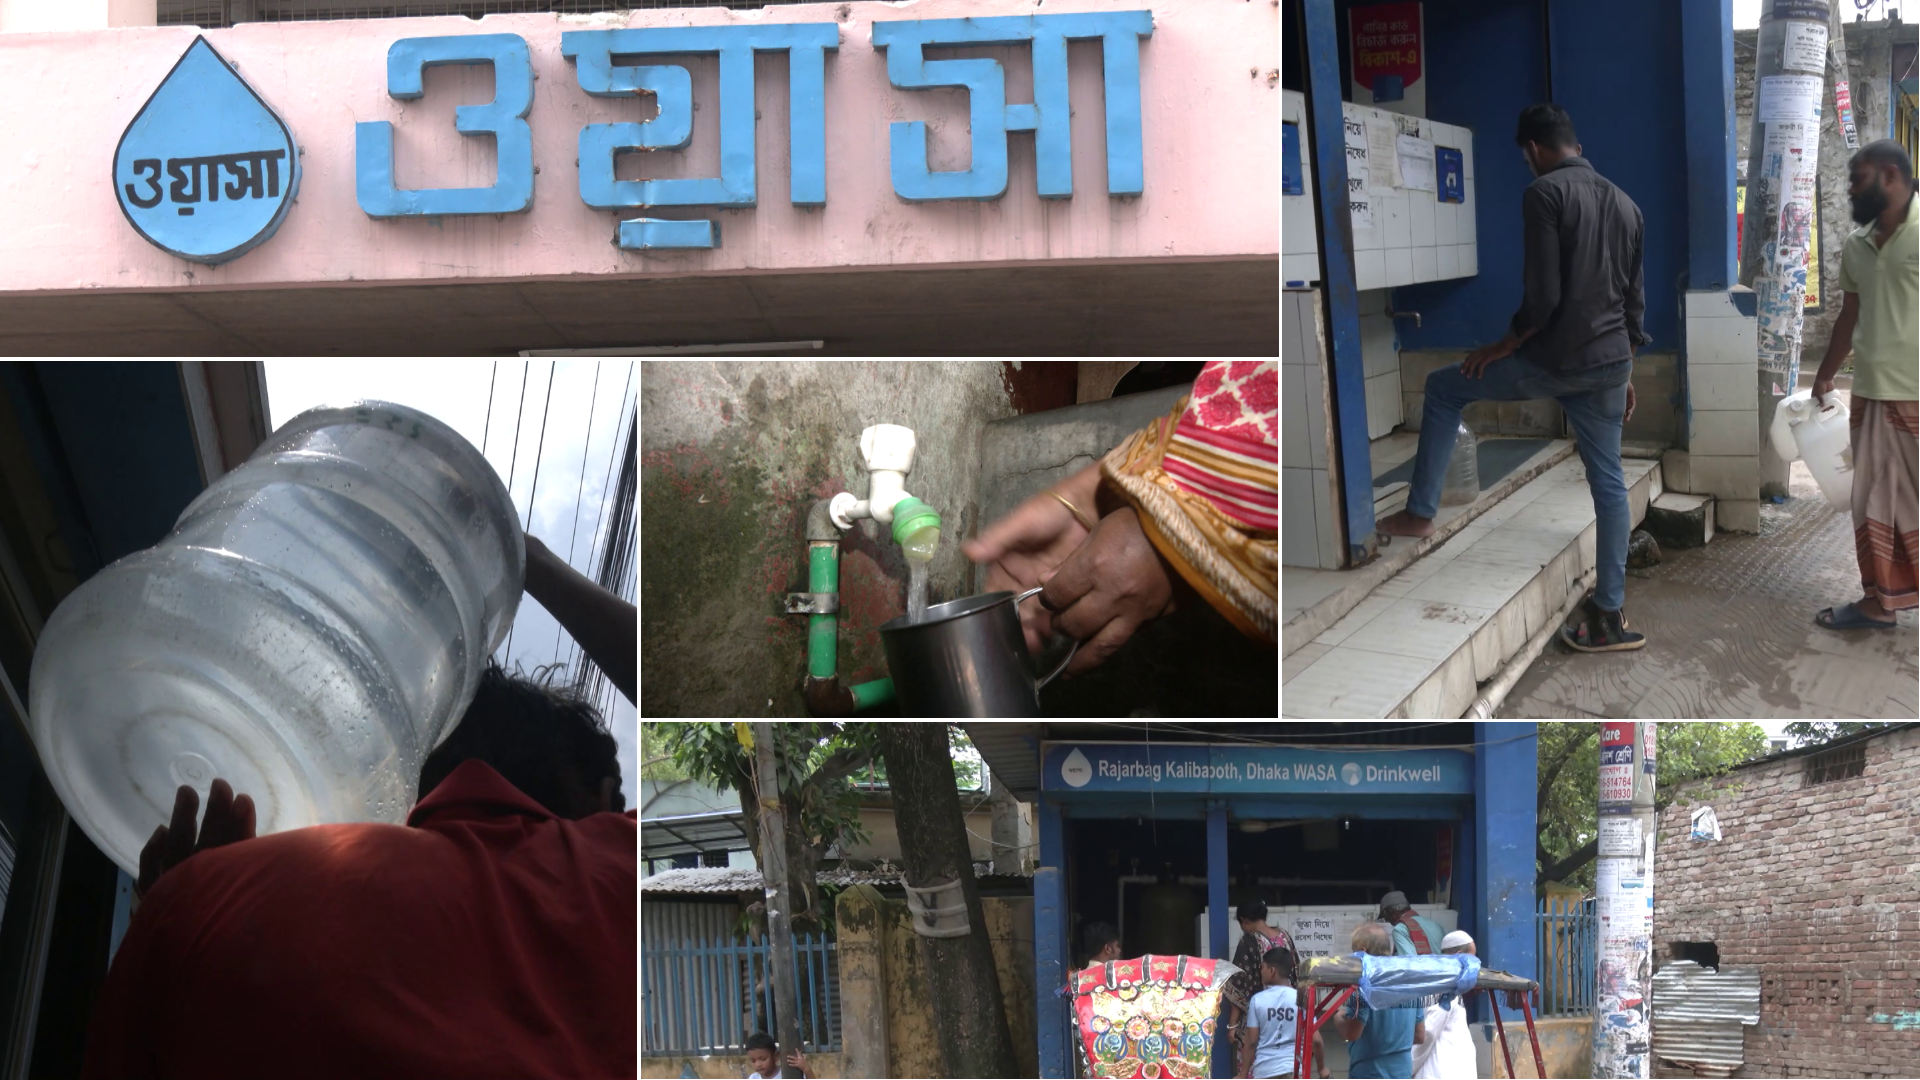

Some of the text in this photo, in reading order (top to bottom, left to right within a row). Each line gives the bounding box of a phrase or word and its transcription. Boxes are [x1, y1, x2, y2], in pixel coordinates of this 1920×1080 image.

[1390, 33, 1417, 46] করুন
[1359, 47, 1417, 67] বিকাশ-এ
[354, 9, 1154, 250] ওয়াসা
[125, 148, 287, 216] ওয়াসা
[1601, 727, 1620, 743] Care
[1099, 758, 1161, 782] Rajarbag
[1247, 762, 1290, 780] Dhaka
[1293, 763, 1337, 781] WASA
[1366, 765, 1441, 782] Drinkwell
[1267, 1007, 1295, 1022] PSC
